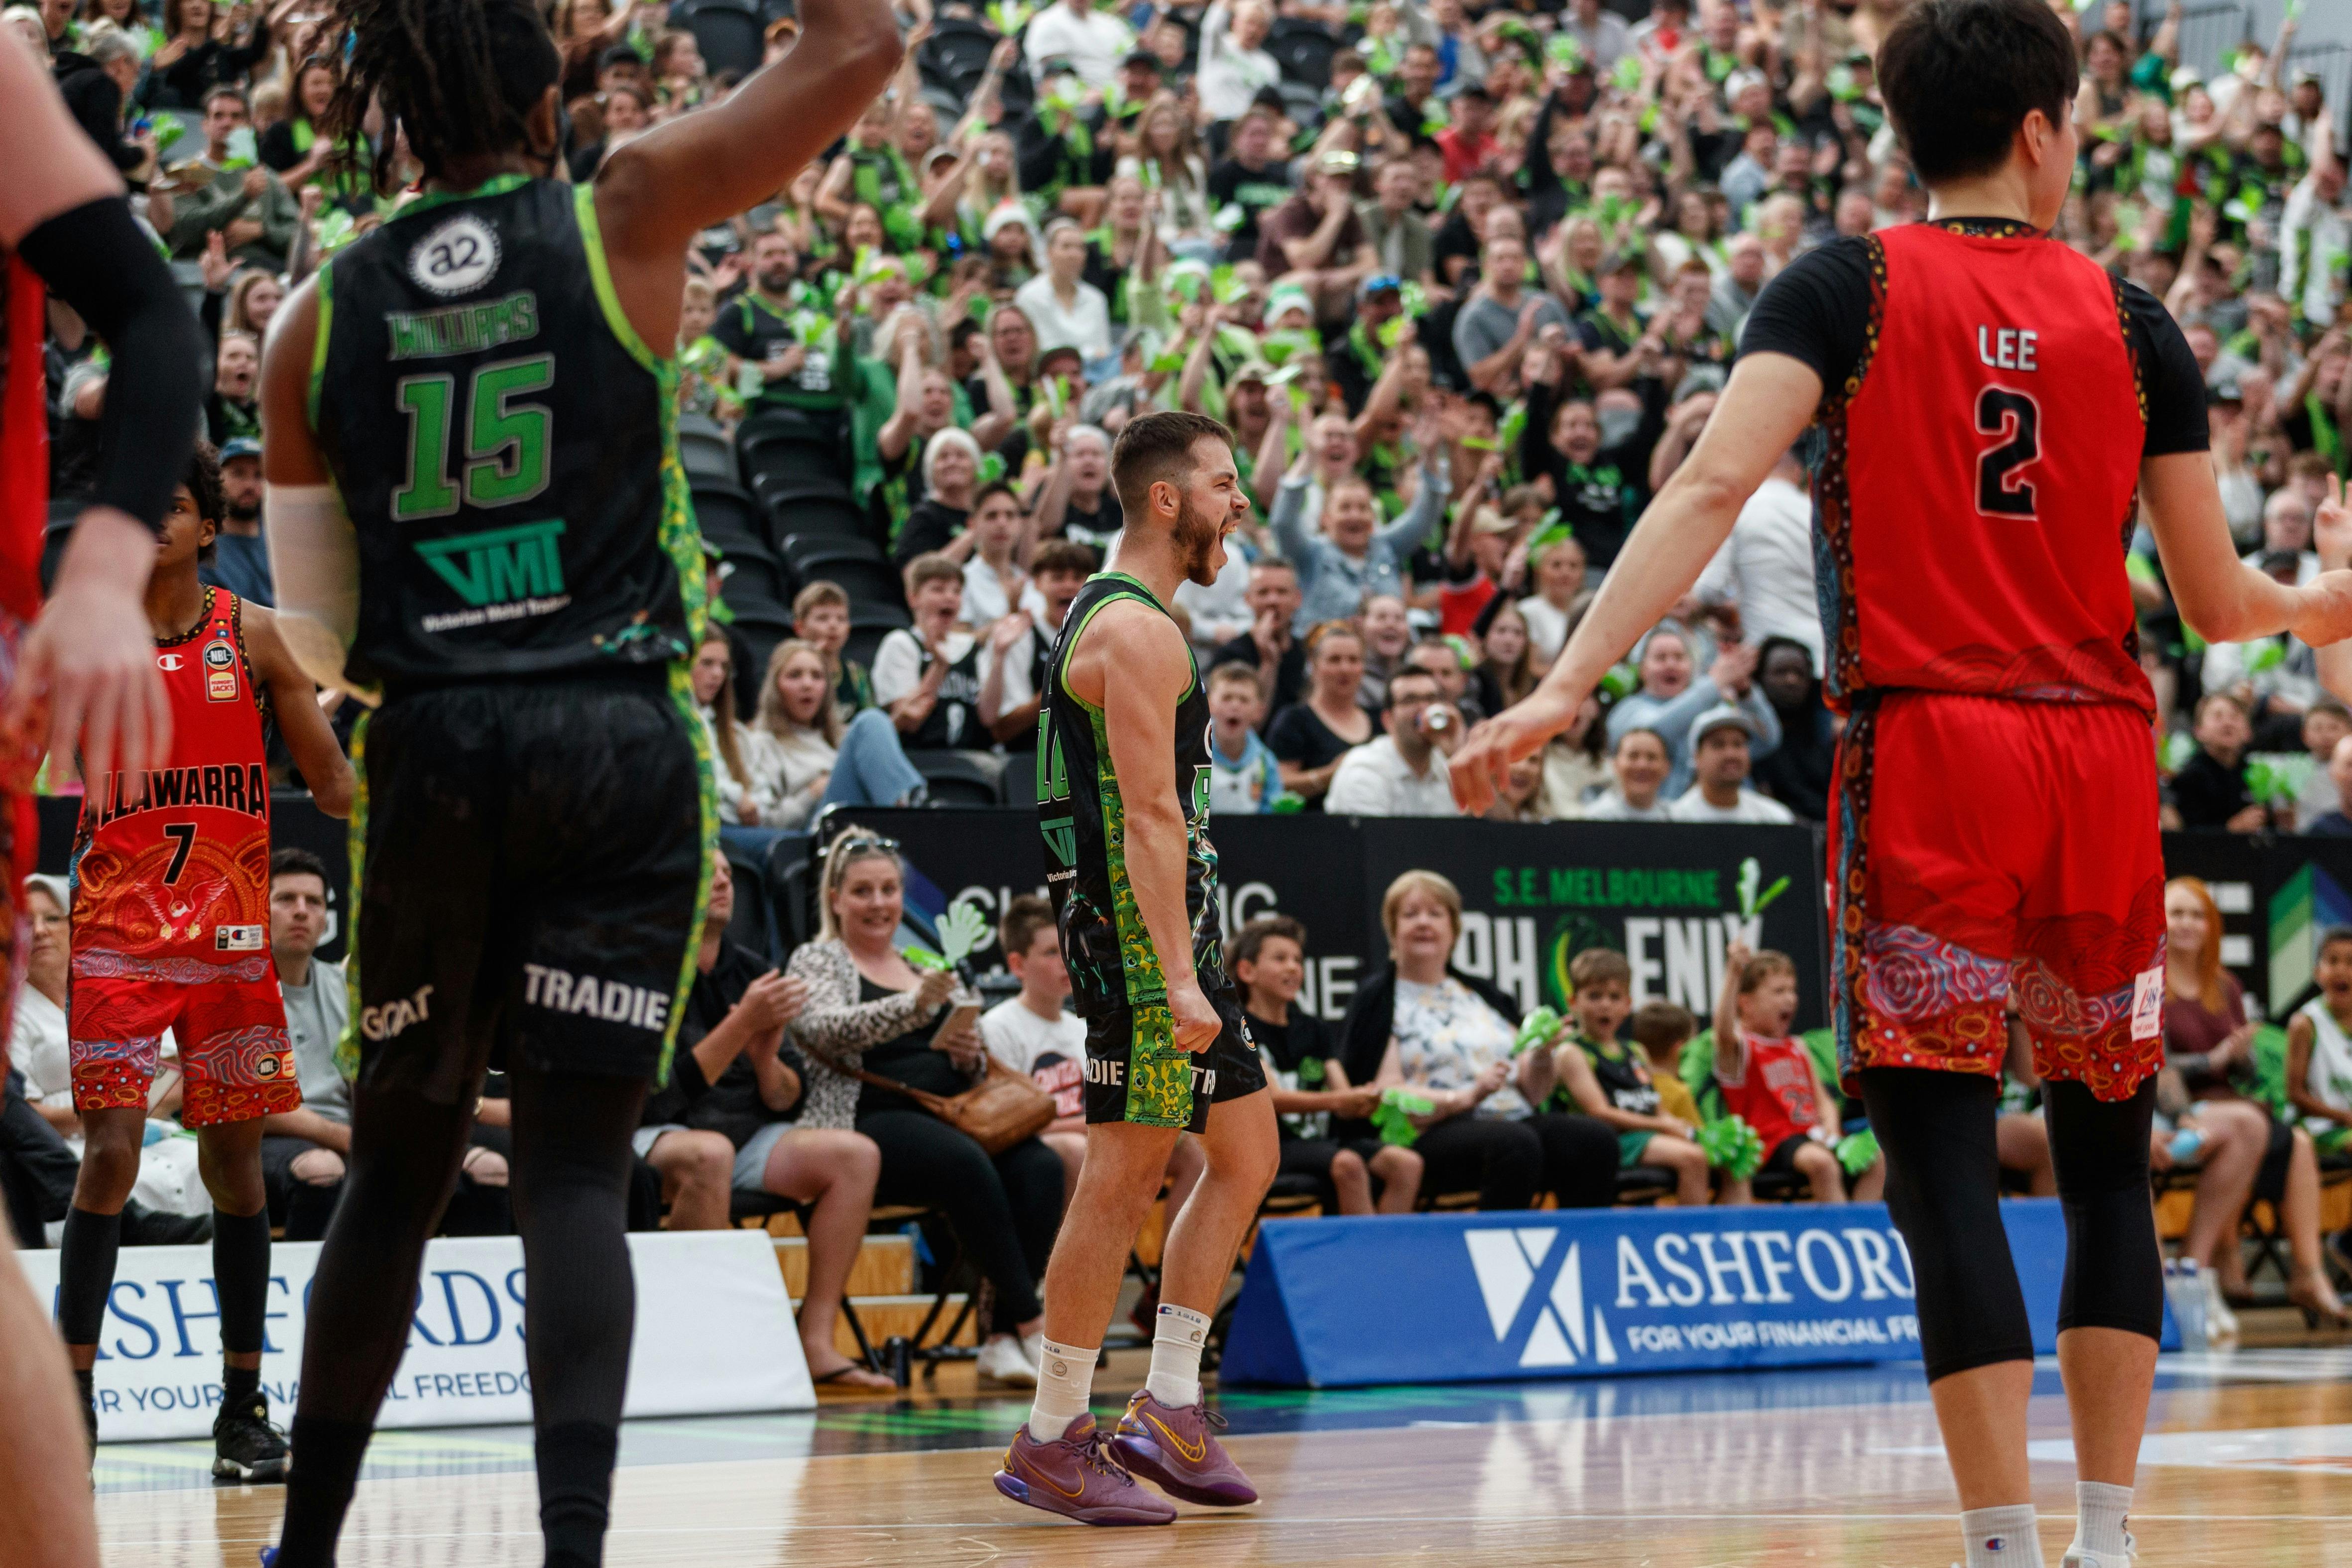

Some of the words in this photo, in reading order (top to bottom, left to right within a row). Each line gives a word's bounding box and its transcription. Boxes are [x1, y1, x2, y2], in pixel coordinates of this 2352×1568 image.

[431, 236, 482, 276] a2
[1978, 324, 2038, 371] LEE
[390, 352, 555, 522] 15
[1975, 382, 2043, 521] 2
[211, 649, 229, 662] NBL
[163, 823, 197, 885] 7
[1549, 868, 1721, 907] MELBOURNE
[524, 963, 671, 1032] TRADIE
[1616, 1227, 1916, 1308] ASHFOR
[1627, 1326, 1683, 1352] FOR
[1683, 1321, 1757, 1350] YOUR
[1757, 1318, 1887, 1347] FINANCIAL
[128, 1383, 224, 1411] YOUR
